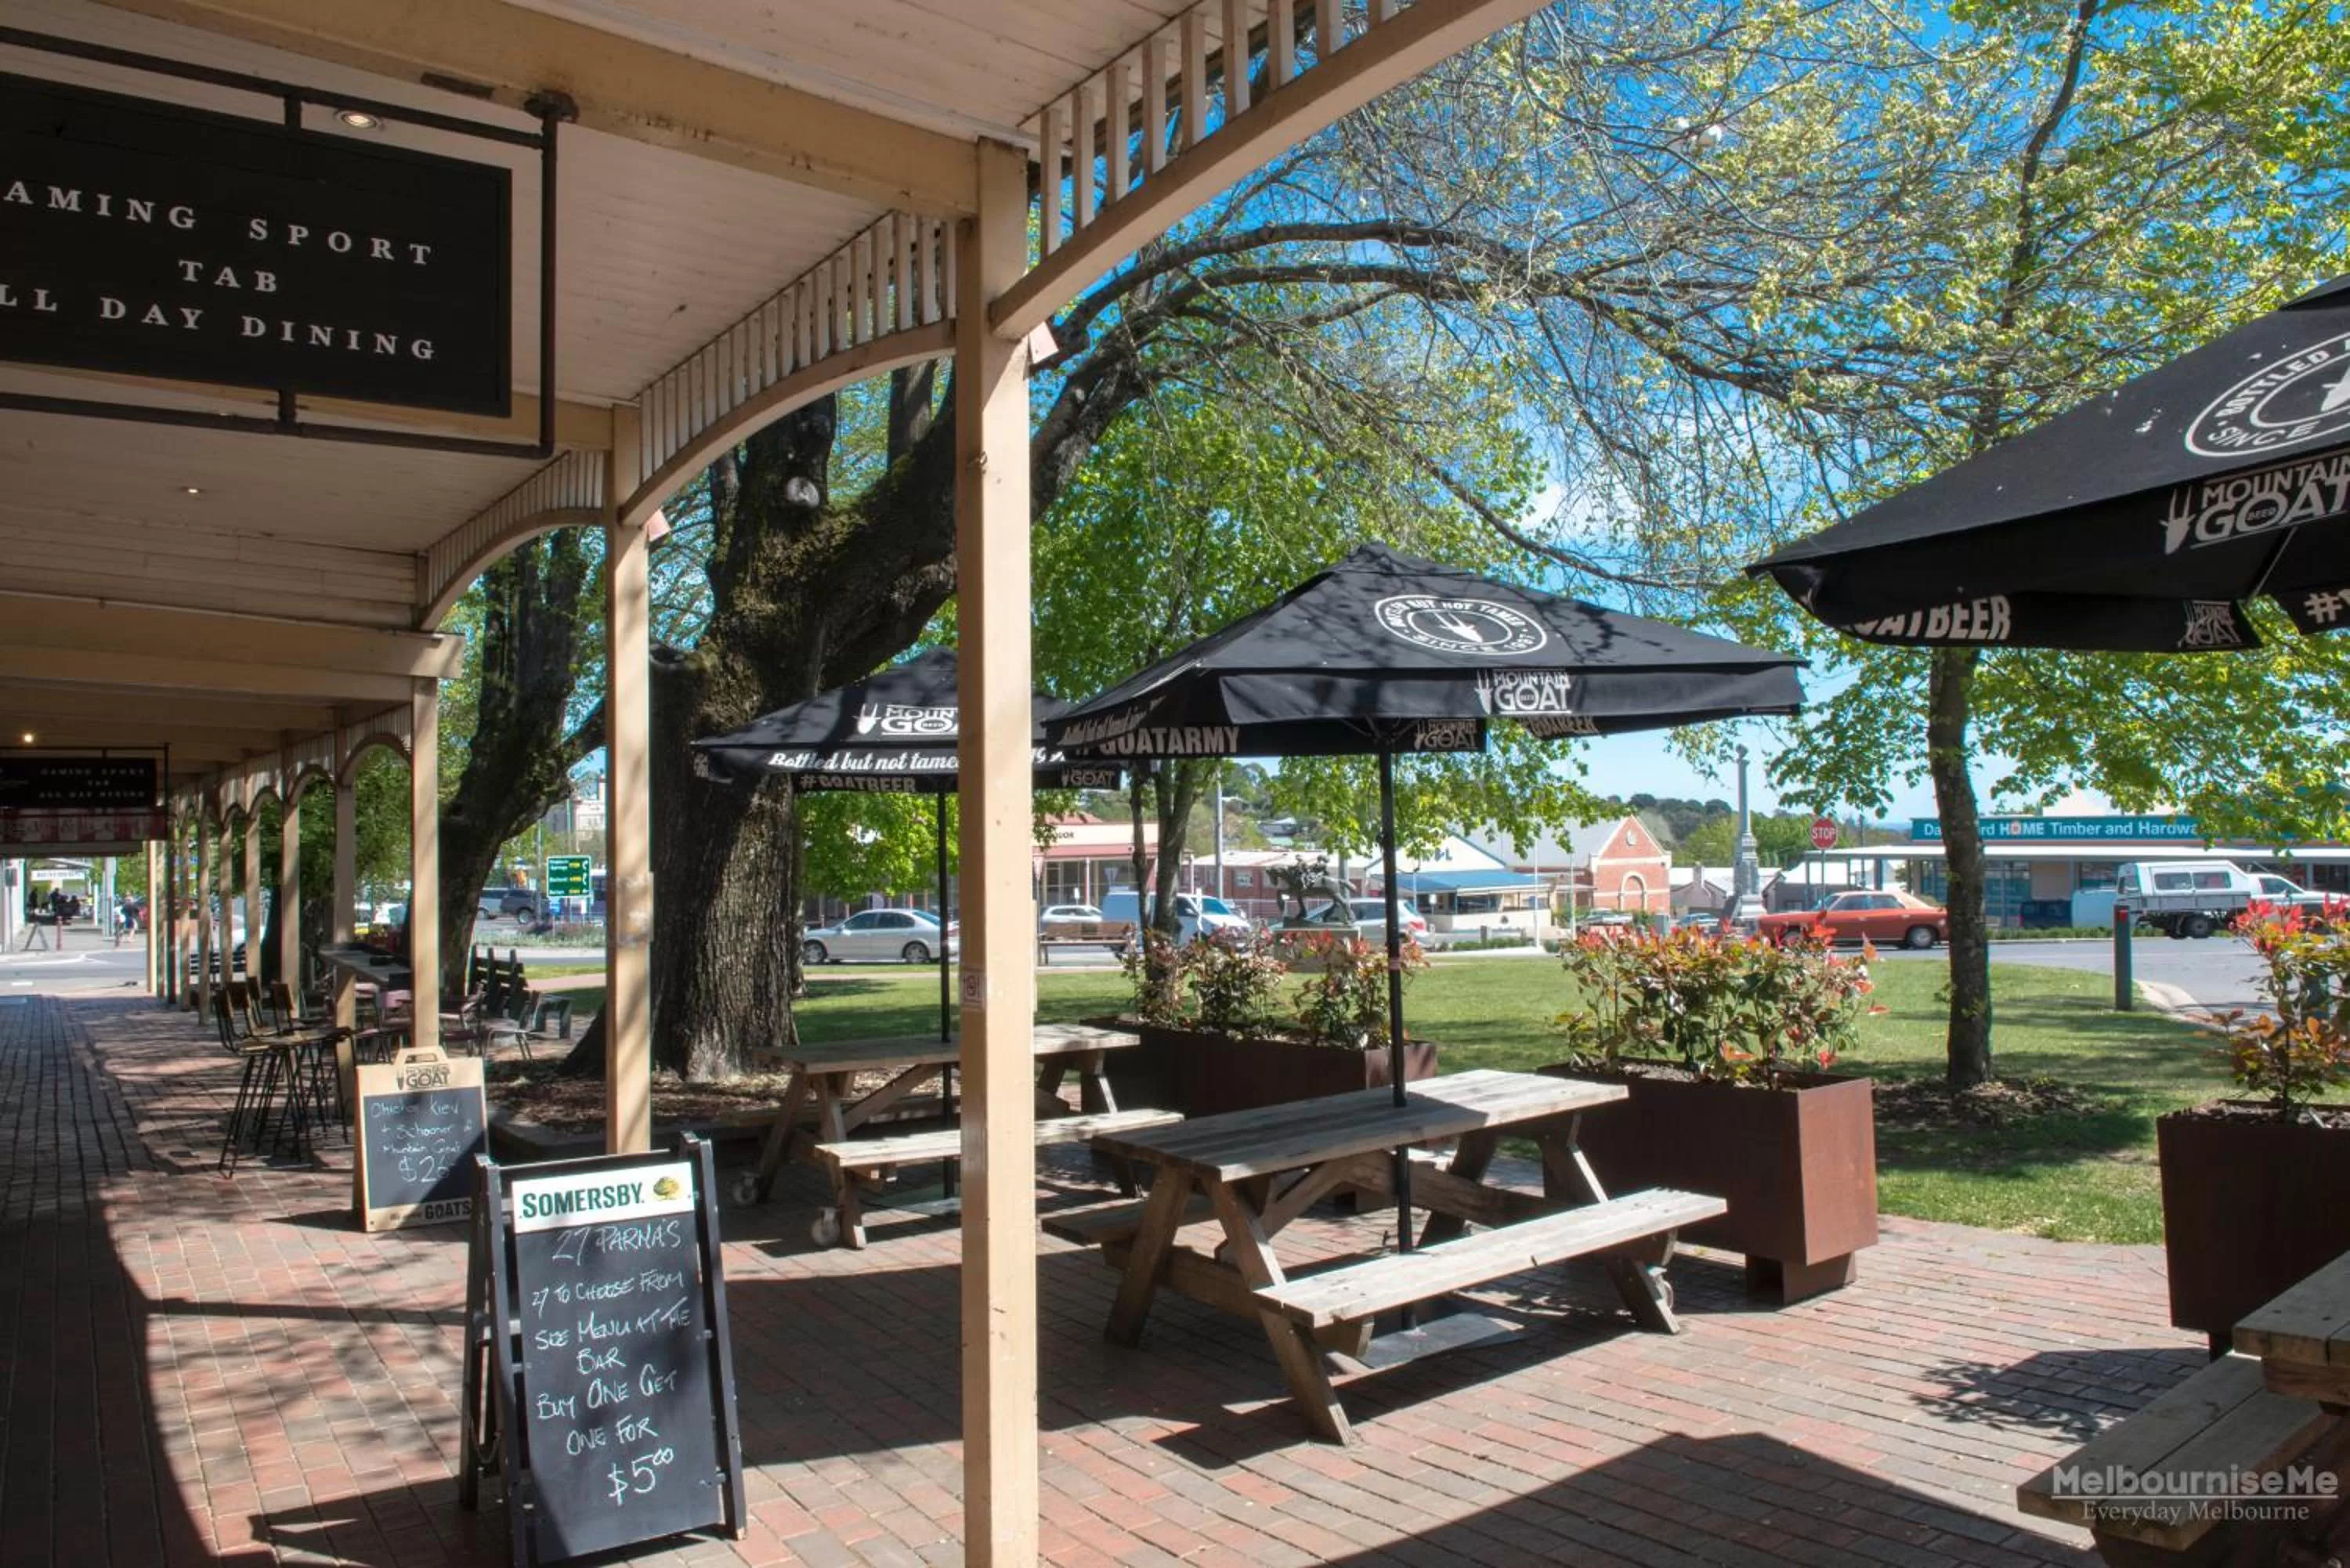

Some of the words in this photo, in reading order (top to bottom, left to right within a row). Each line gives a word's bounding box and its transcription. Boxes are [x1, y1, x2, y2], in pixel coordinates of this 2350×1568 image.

[249, 219, 432, 265] SPORT
[179, 260, 277, 293] TAB
[99, 296, 204, 331] DAY
[241, 316, 435, 360] DINING
[2215, 349, 2330, 418] BOTTLED
[2207, 420, 2321, 447] SINCE
[2194, 476, 2350, 541] GOAT
[1493, 670, 1571, 687] MOUNTAIN
[1494, 681, 1571, 711] GOAT
[881, 717, 958, 733] GO
[885, 706, 958, 718] MOUN
[1424, 730, 1478, 748] GOAT
[768, 752, 838, 771] Bottled
[841, 752, 873, 771] but
[875, 752, 908, 771] not
[909, 752, 958, 770] tame
[1070, 768, 1115, 786] GOAT
[1811, 826, 1835, 840] STOP
[2000, 822, 2044, 836] HOME
[2051, 821, 2102, 836] Timber
[2106, 821, 2134, 836] and
[2138, 821, 2198, 836] Hardwa
[406, 1072, 450, 1089] GOAT
[521, 1181, 645, 1219] SOMERSBY
[551, 1226, 591, 1266] 27
[532, 1287, 550, 1320] 27
[555, 1281, 570, 1304] TO
[576, 1277, 635, 1302] CHOOSE
[638, 1267, 684, 1292] FROM
[535, 1328, 569, 1350] SEE
[635, 1308, 661, 1334] AT
[660, 1295, 691, 1329] THE
[577, 1346, 627, 1375] BAR
[537, 1392, 577, 1420] BUY
[588, 1378, 630, 1409] ONE
[639, 1363, 678, 1397] GET
[566, 1427, 607, 1456] ONE
[616, 1414, 659, 1444] FOR
